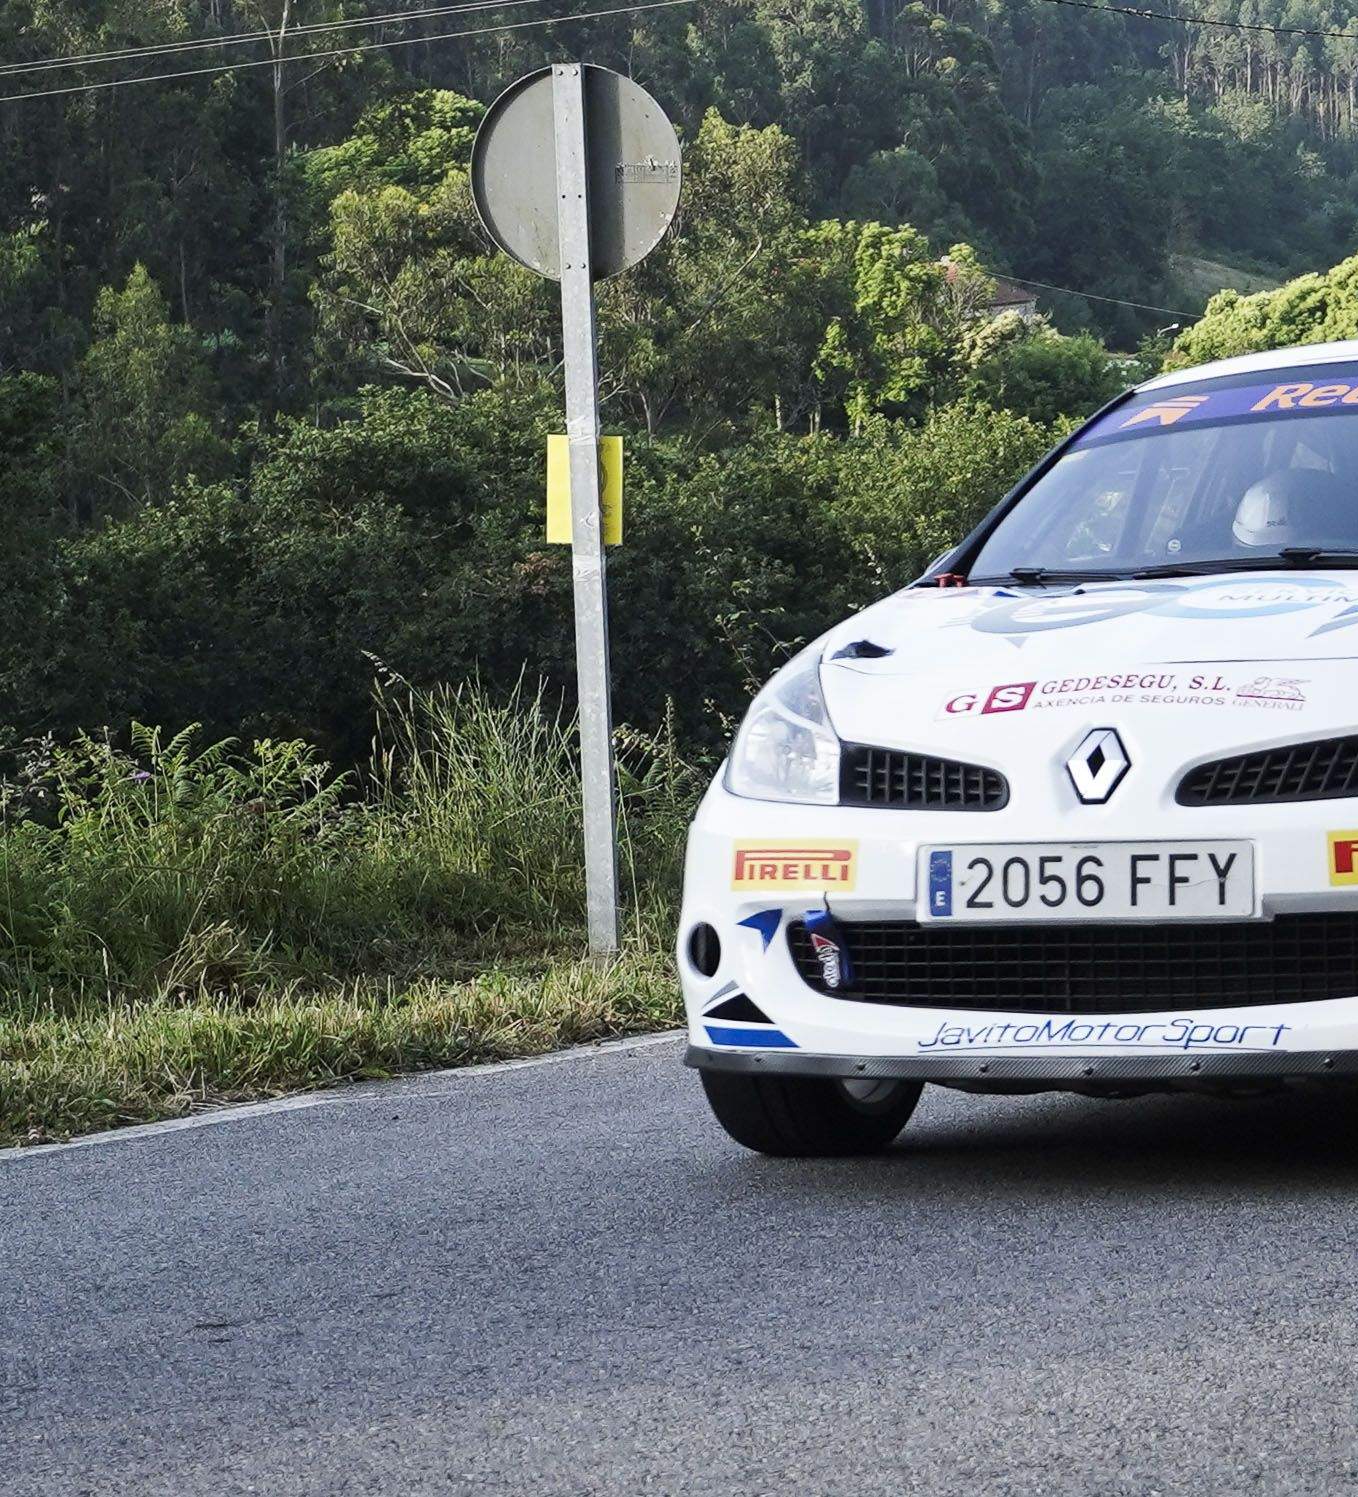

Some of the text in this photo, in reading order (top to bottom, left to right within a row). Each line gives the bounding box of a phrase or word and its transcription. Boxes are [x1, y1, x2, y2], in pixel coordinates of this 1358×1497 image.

[1188, 676, 1232, 691] S.L.
[1033, 694, 1226, 708] AXENCIA DE SEGUROS
[735, 850, 852, 880] PIRELLI
[966, 853, 1237, 908] 2056 FFY
[935, 890, 946, 906] E
